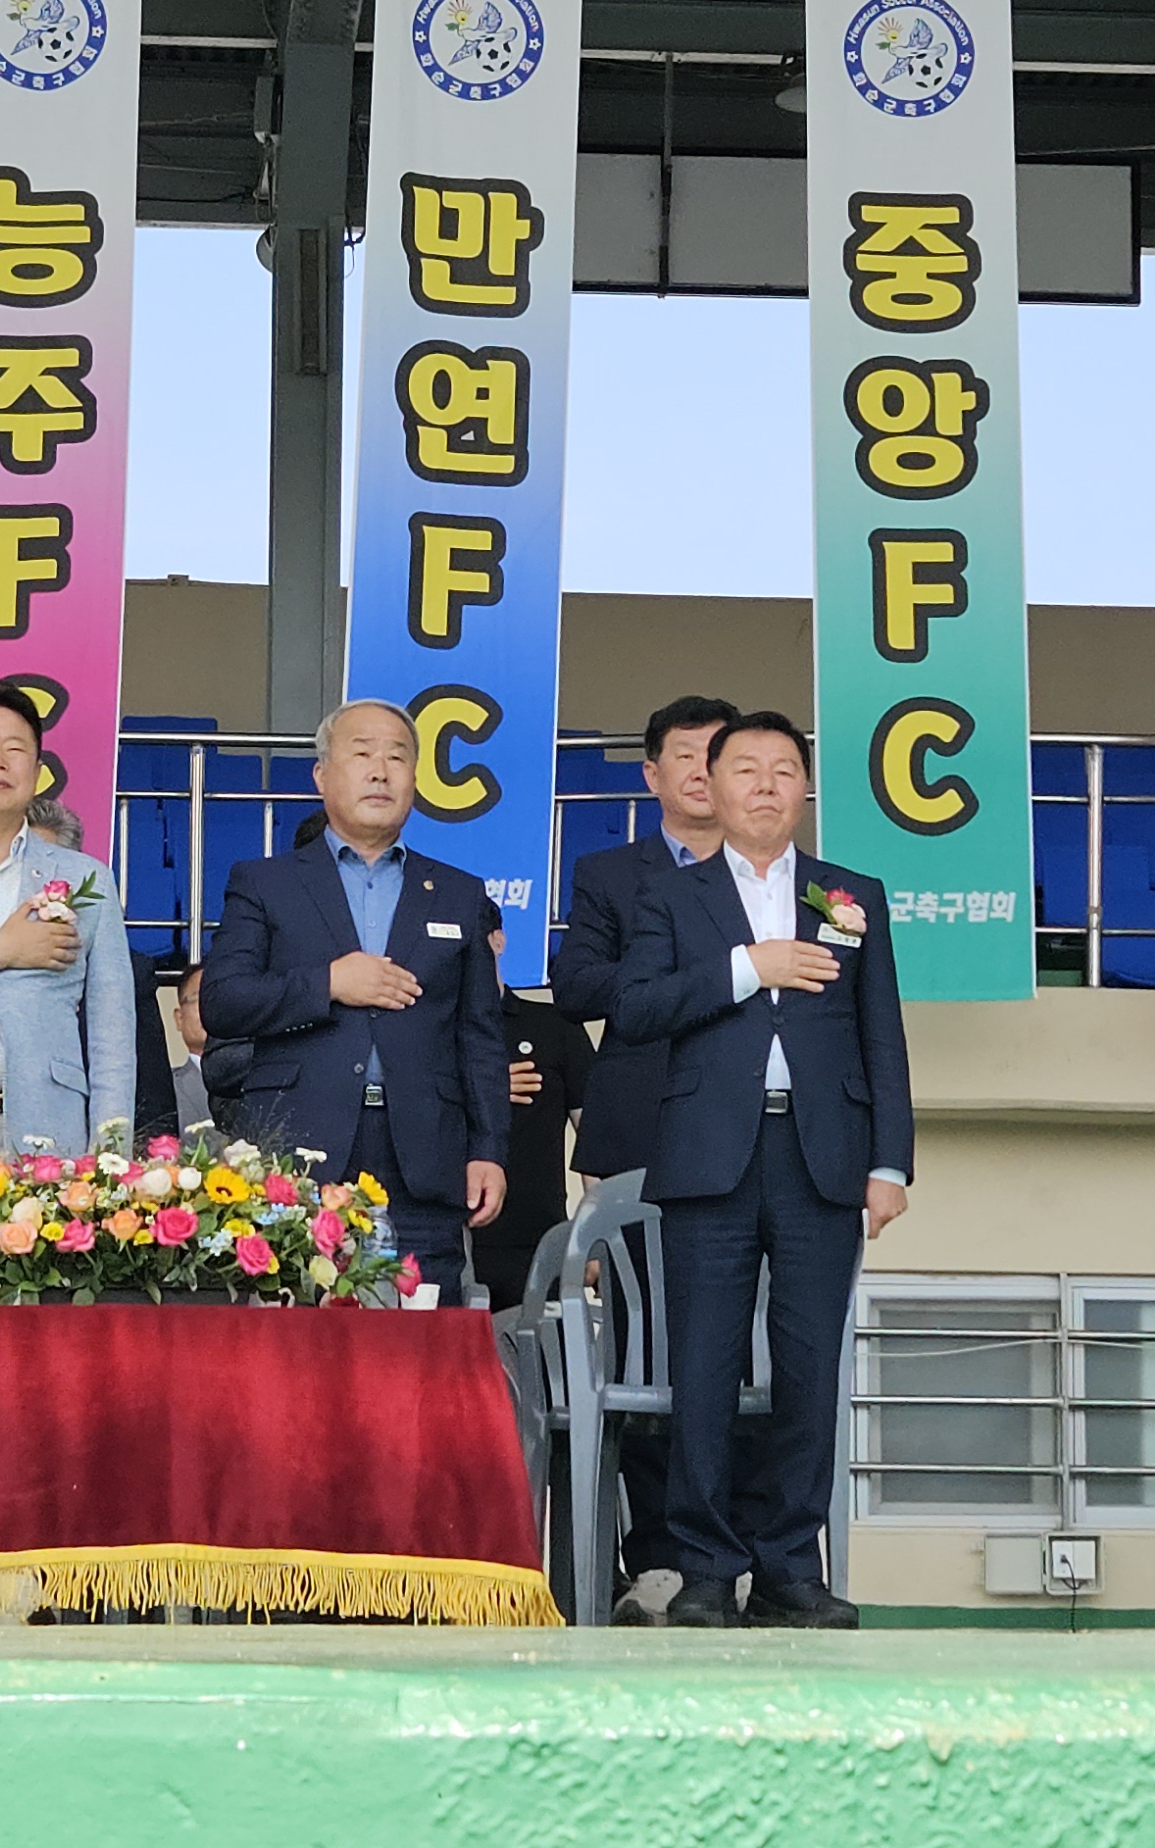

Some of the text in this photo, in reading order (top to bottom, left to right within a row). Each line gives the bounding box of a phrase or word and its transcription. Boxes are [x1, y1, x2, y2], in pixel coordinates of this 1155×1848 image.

[847, 4, 881, 44] Hwasun
[844, 192, 988, 835] 중앙FC
[484, 878, 533, 910] 협회
[890, 890, 1017, 923] 군축구협회
